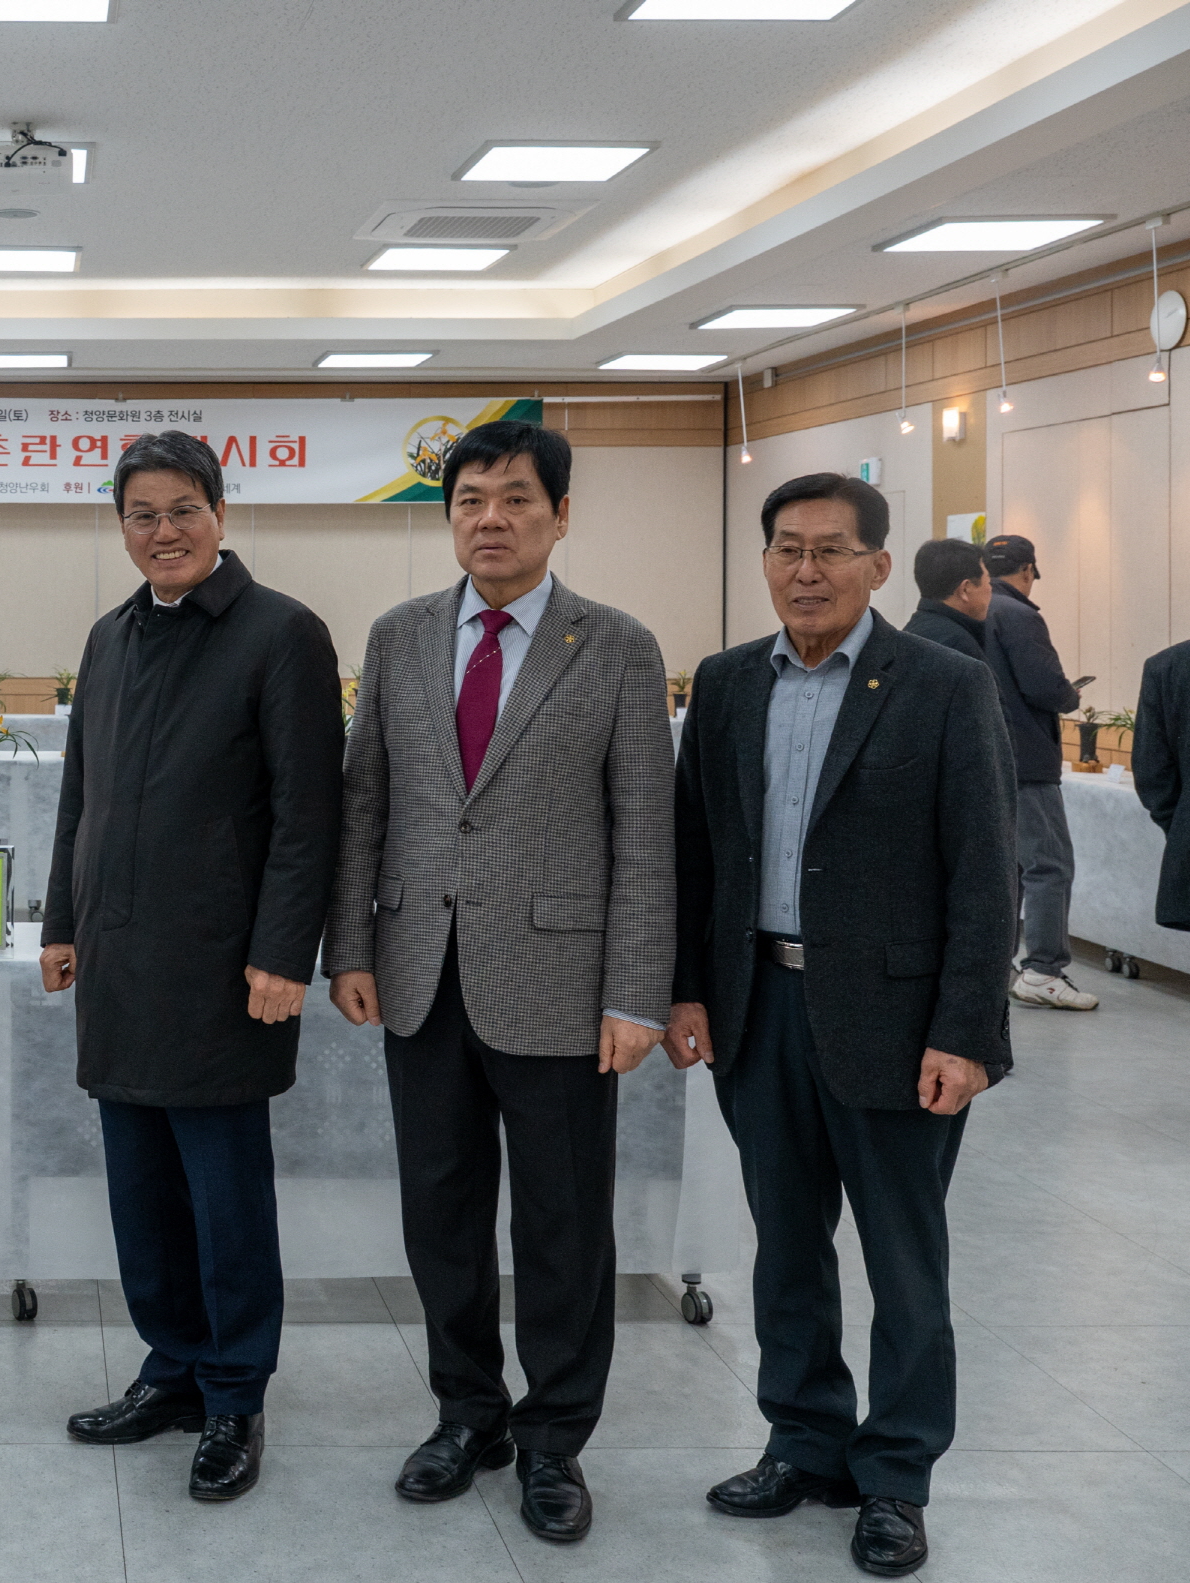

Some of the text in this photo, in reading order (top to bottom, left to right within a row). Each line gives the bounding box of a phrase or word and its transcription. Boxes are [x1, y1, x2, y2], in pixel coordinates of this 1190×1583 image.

[48, 409, 73, 422] 장소
[82, 409, 141, 422] 청양문화원
[144, 409, 165, 423] 3층
[168, 409, 203, 423] 전시실
[63, 482, 84, 494] 후원
